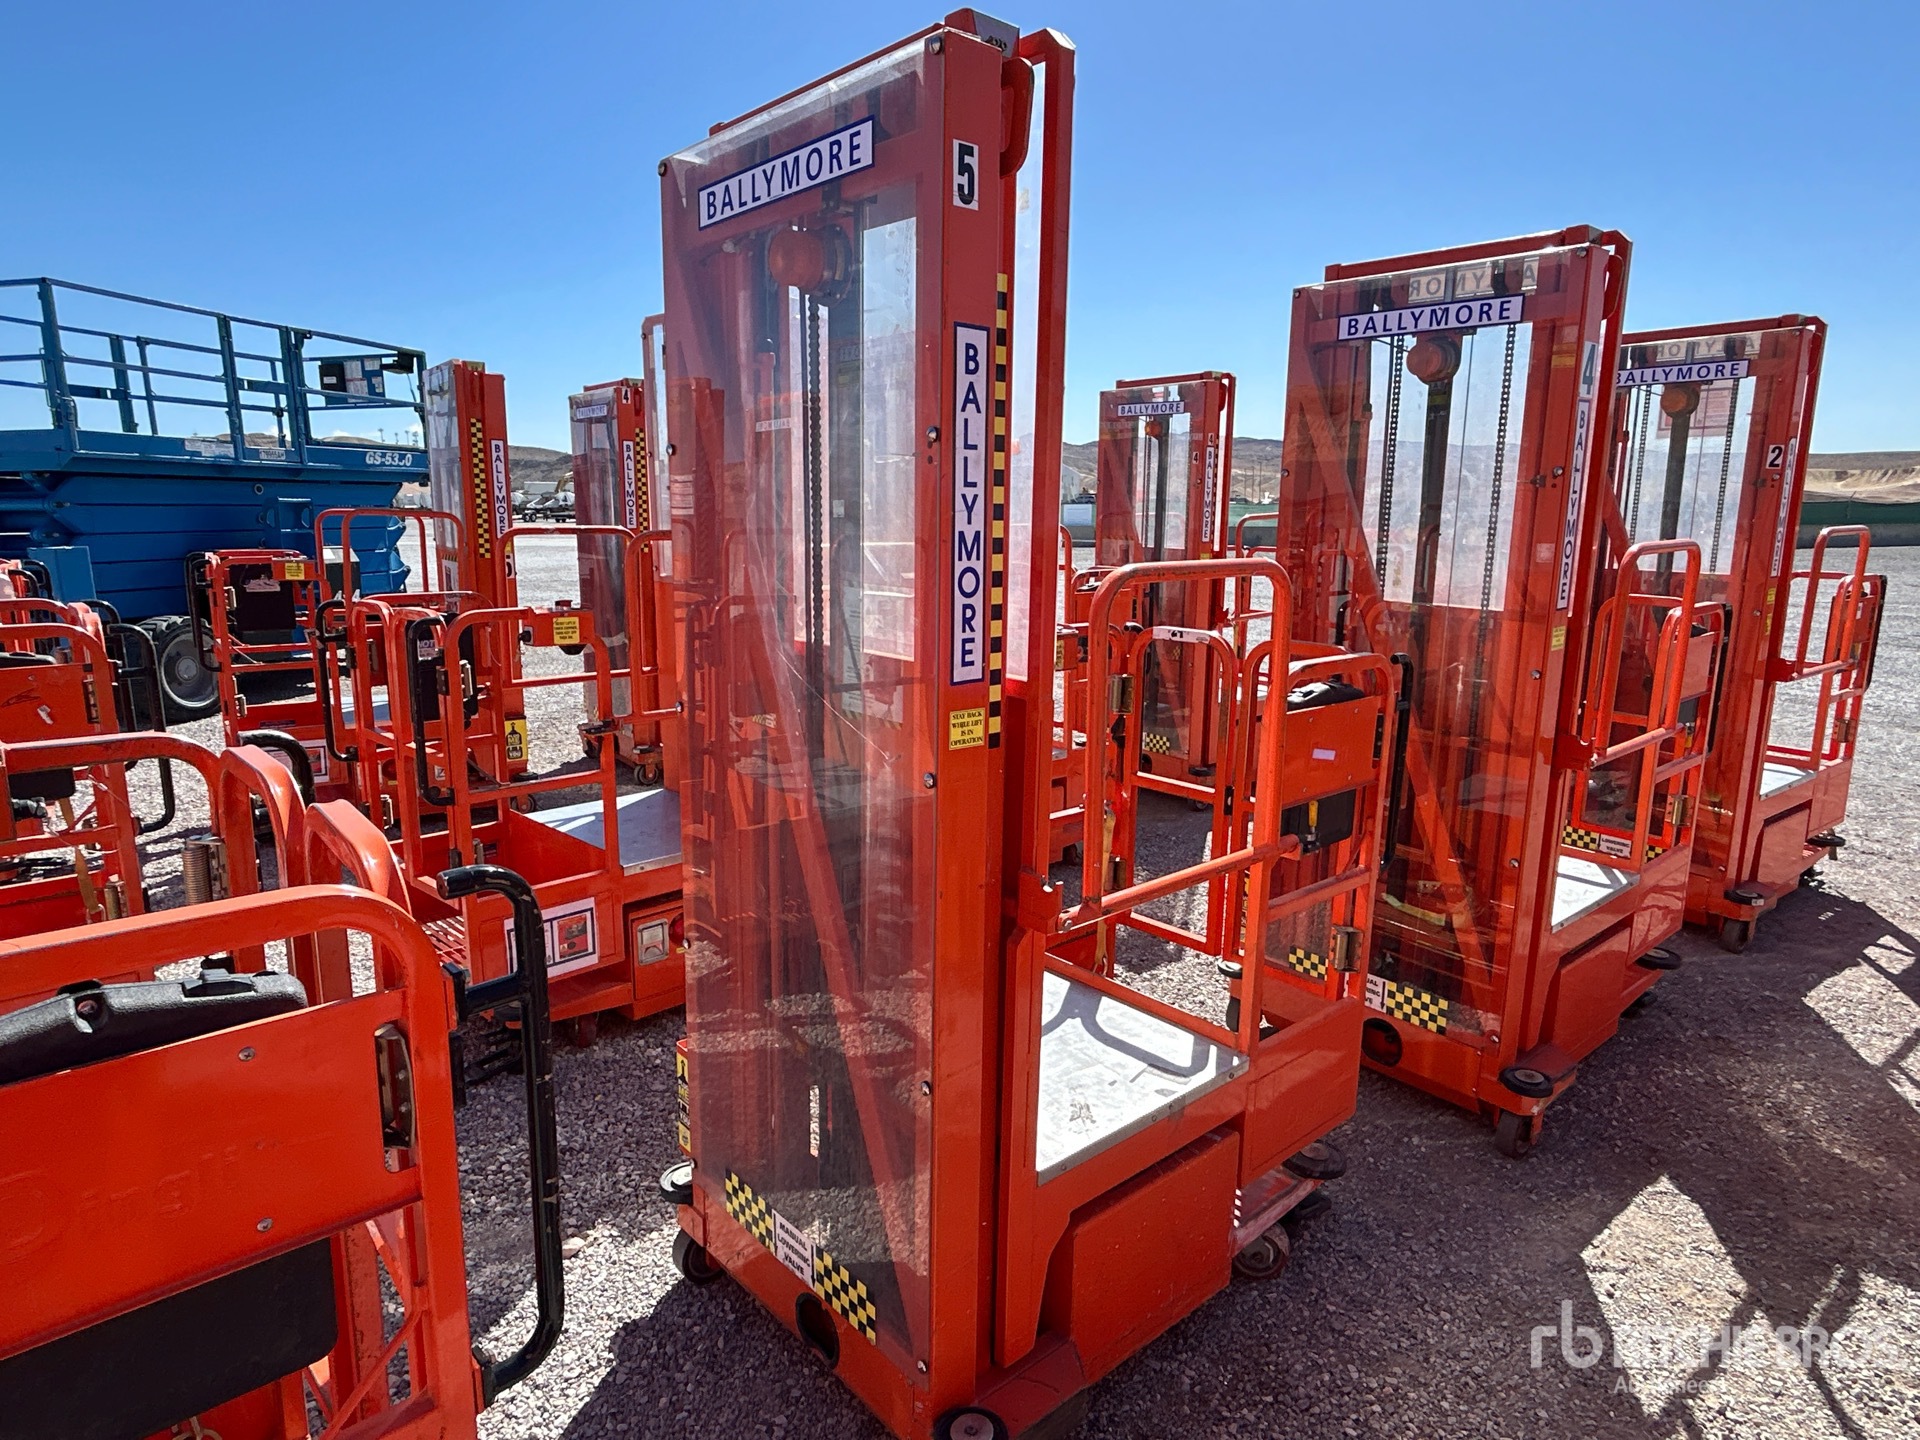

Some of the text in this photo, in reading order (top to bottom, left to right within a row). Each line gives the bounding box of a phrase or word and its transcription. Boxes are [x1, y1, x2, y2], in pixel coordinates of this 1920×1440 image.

[706, 129, 861, 221] BALLYMORE
[956, 144, 975, 206] 5
[1347, 300, 1513, 337] BALLYMORE
[1582, 343, 1596, 395] 4
[1616, 362, 1740, 385] BALLYMORE
[623, 388, 630, 403] 4
[1120, 403, 1181, 415] BALLYMORE
[1193, 452, 1198, 463] 4
[1768, 445, 1783, 468] 2
[494, 444, 506, 535] BALLYMORE
[625, 444, 636, 526] BALLYMORE
[1204, 450, 1212, 538] BALLYMORE
[957, 341, 982, 668] BALLYMORE
[1560, 409, 1585, 601] BALLYMORE
[952, 721, 970, 729] WHILE
[950, 738, 983, 746] OPERATION
[1601, 837, 1630, 849] LOWERING
[777, 1233, 811, 1268] LOWERING
[779, 1221, 808, 1252] MANUAL
[783, 1252, 805, 1276] VALVE
